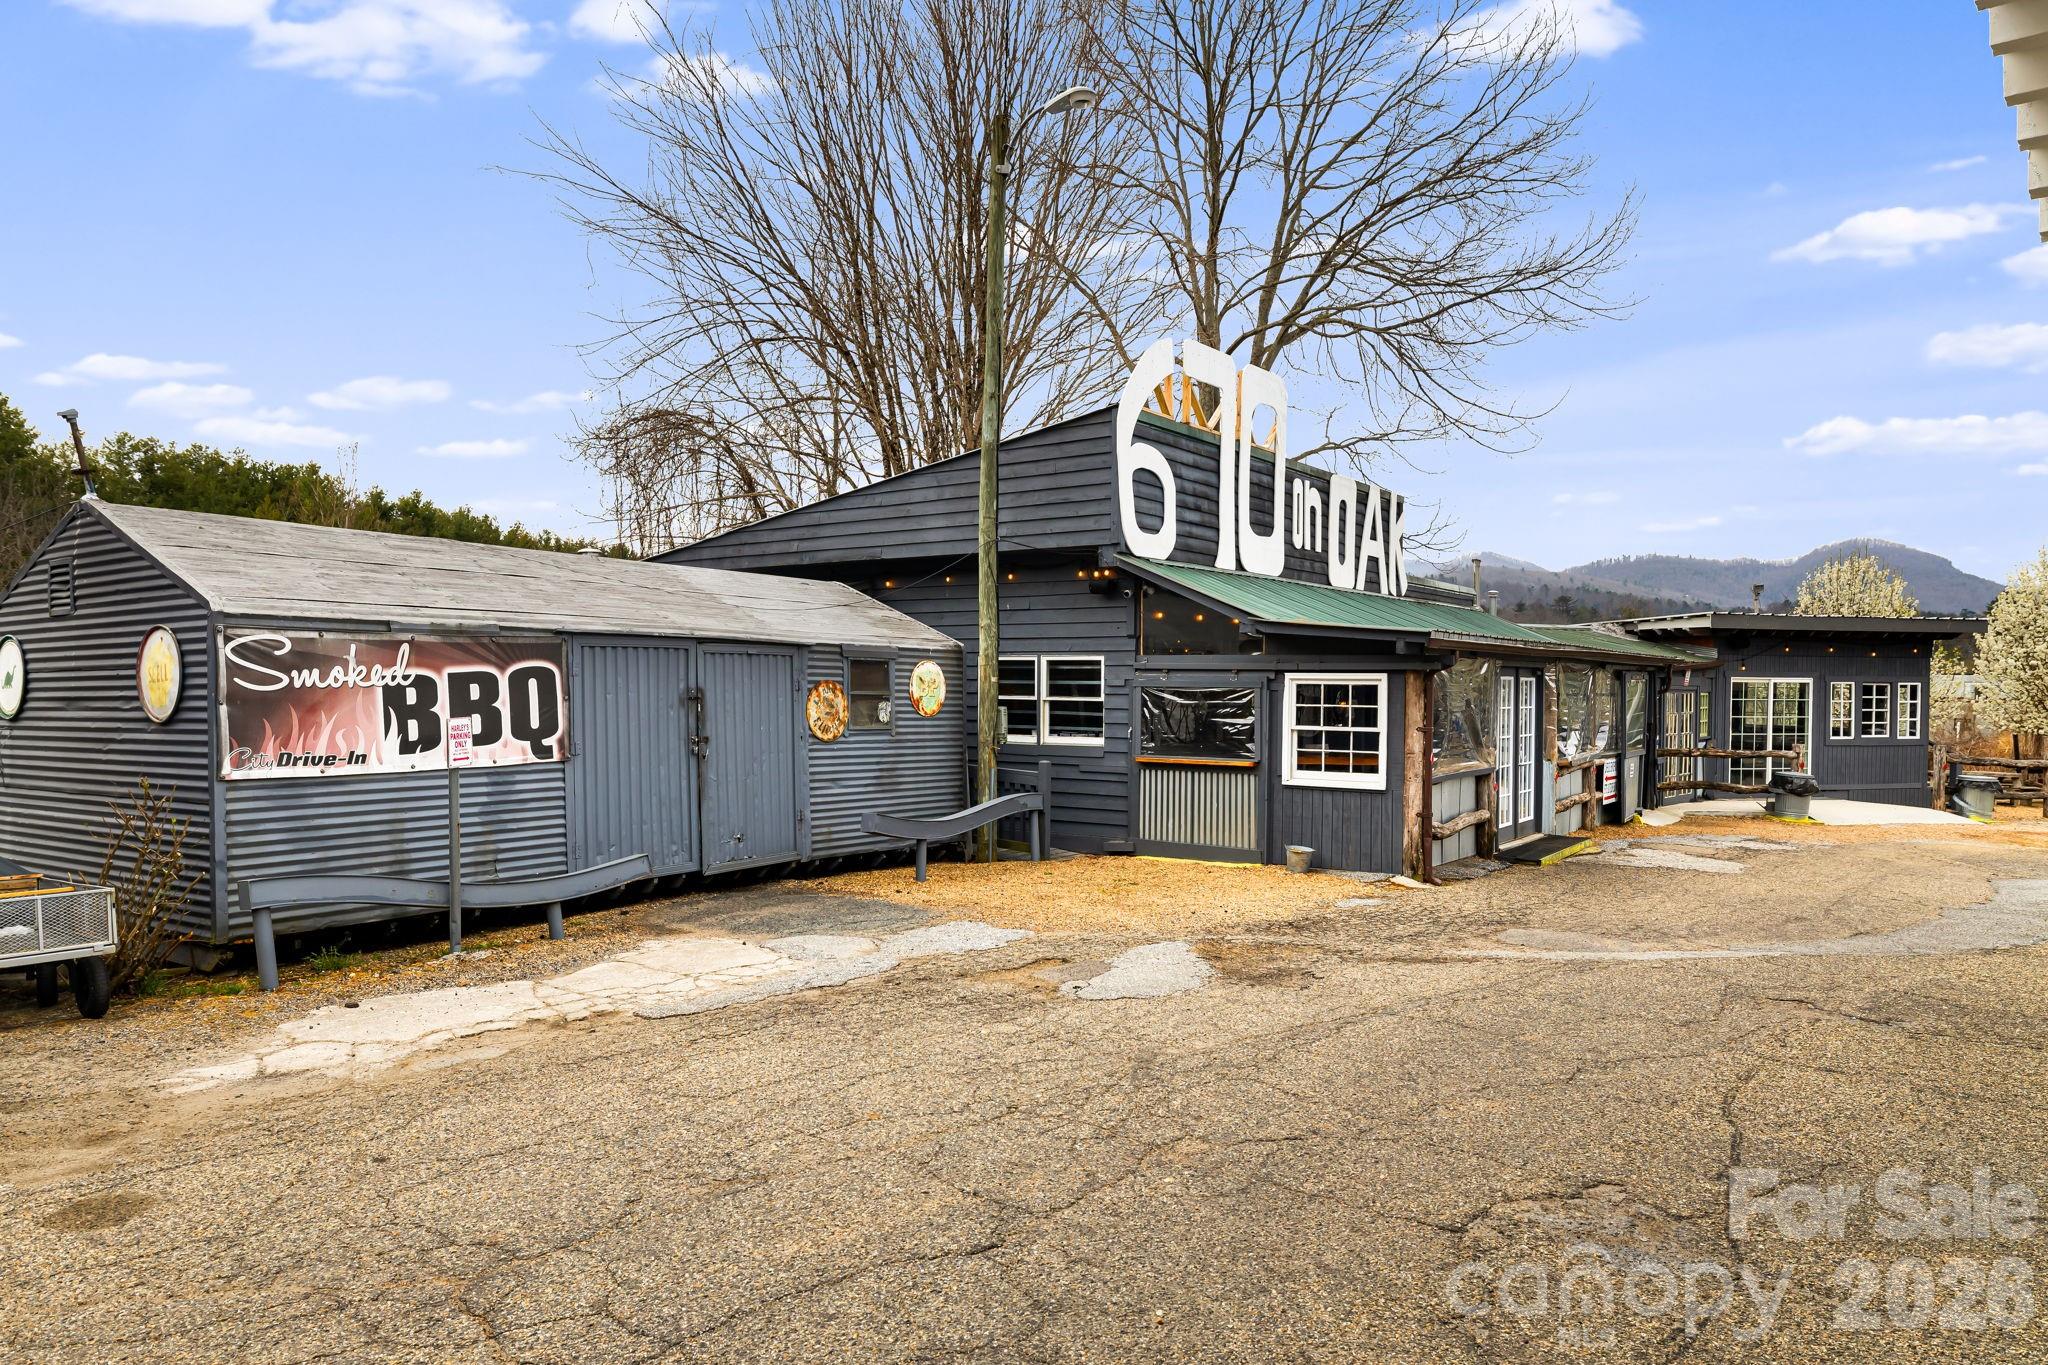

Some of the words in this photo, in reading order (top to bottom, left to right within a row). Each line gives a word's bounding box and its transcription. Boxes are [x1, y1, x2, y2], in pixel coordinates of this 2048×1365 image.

[1328, 473, 1409, 597] OAK
[224, 634, 416, 692] Smoked
[381, 665, 560, 760] BBQ
[449, 731, 471, 741] PARKING
[450, 723, 470, 732] HARLEY'S
[454, 740, 467, 749] ONLY
[229, 746, 274, 772] City
[277, 750, 368, 768] Drive-In
